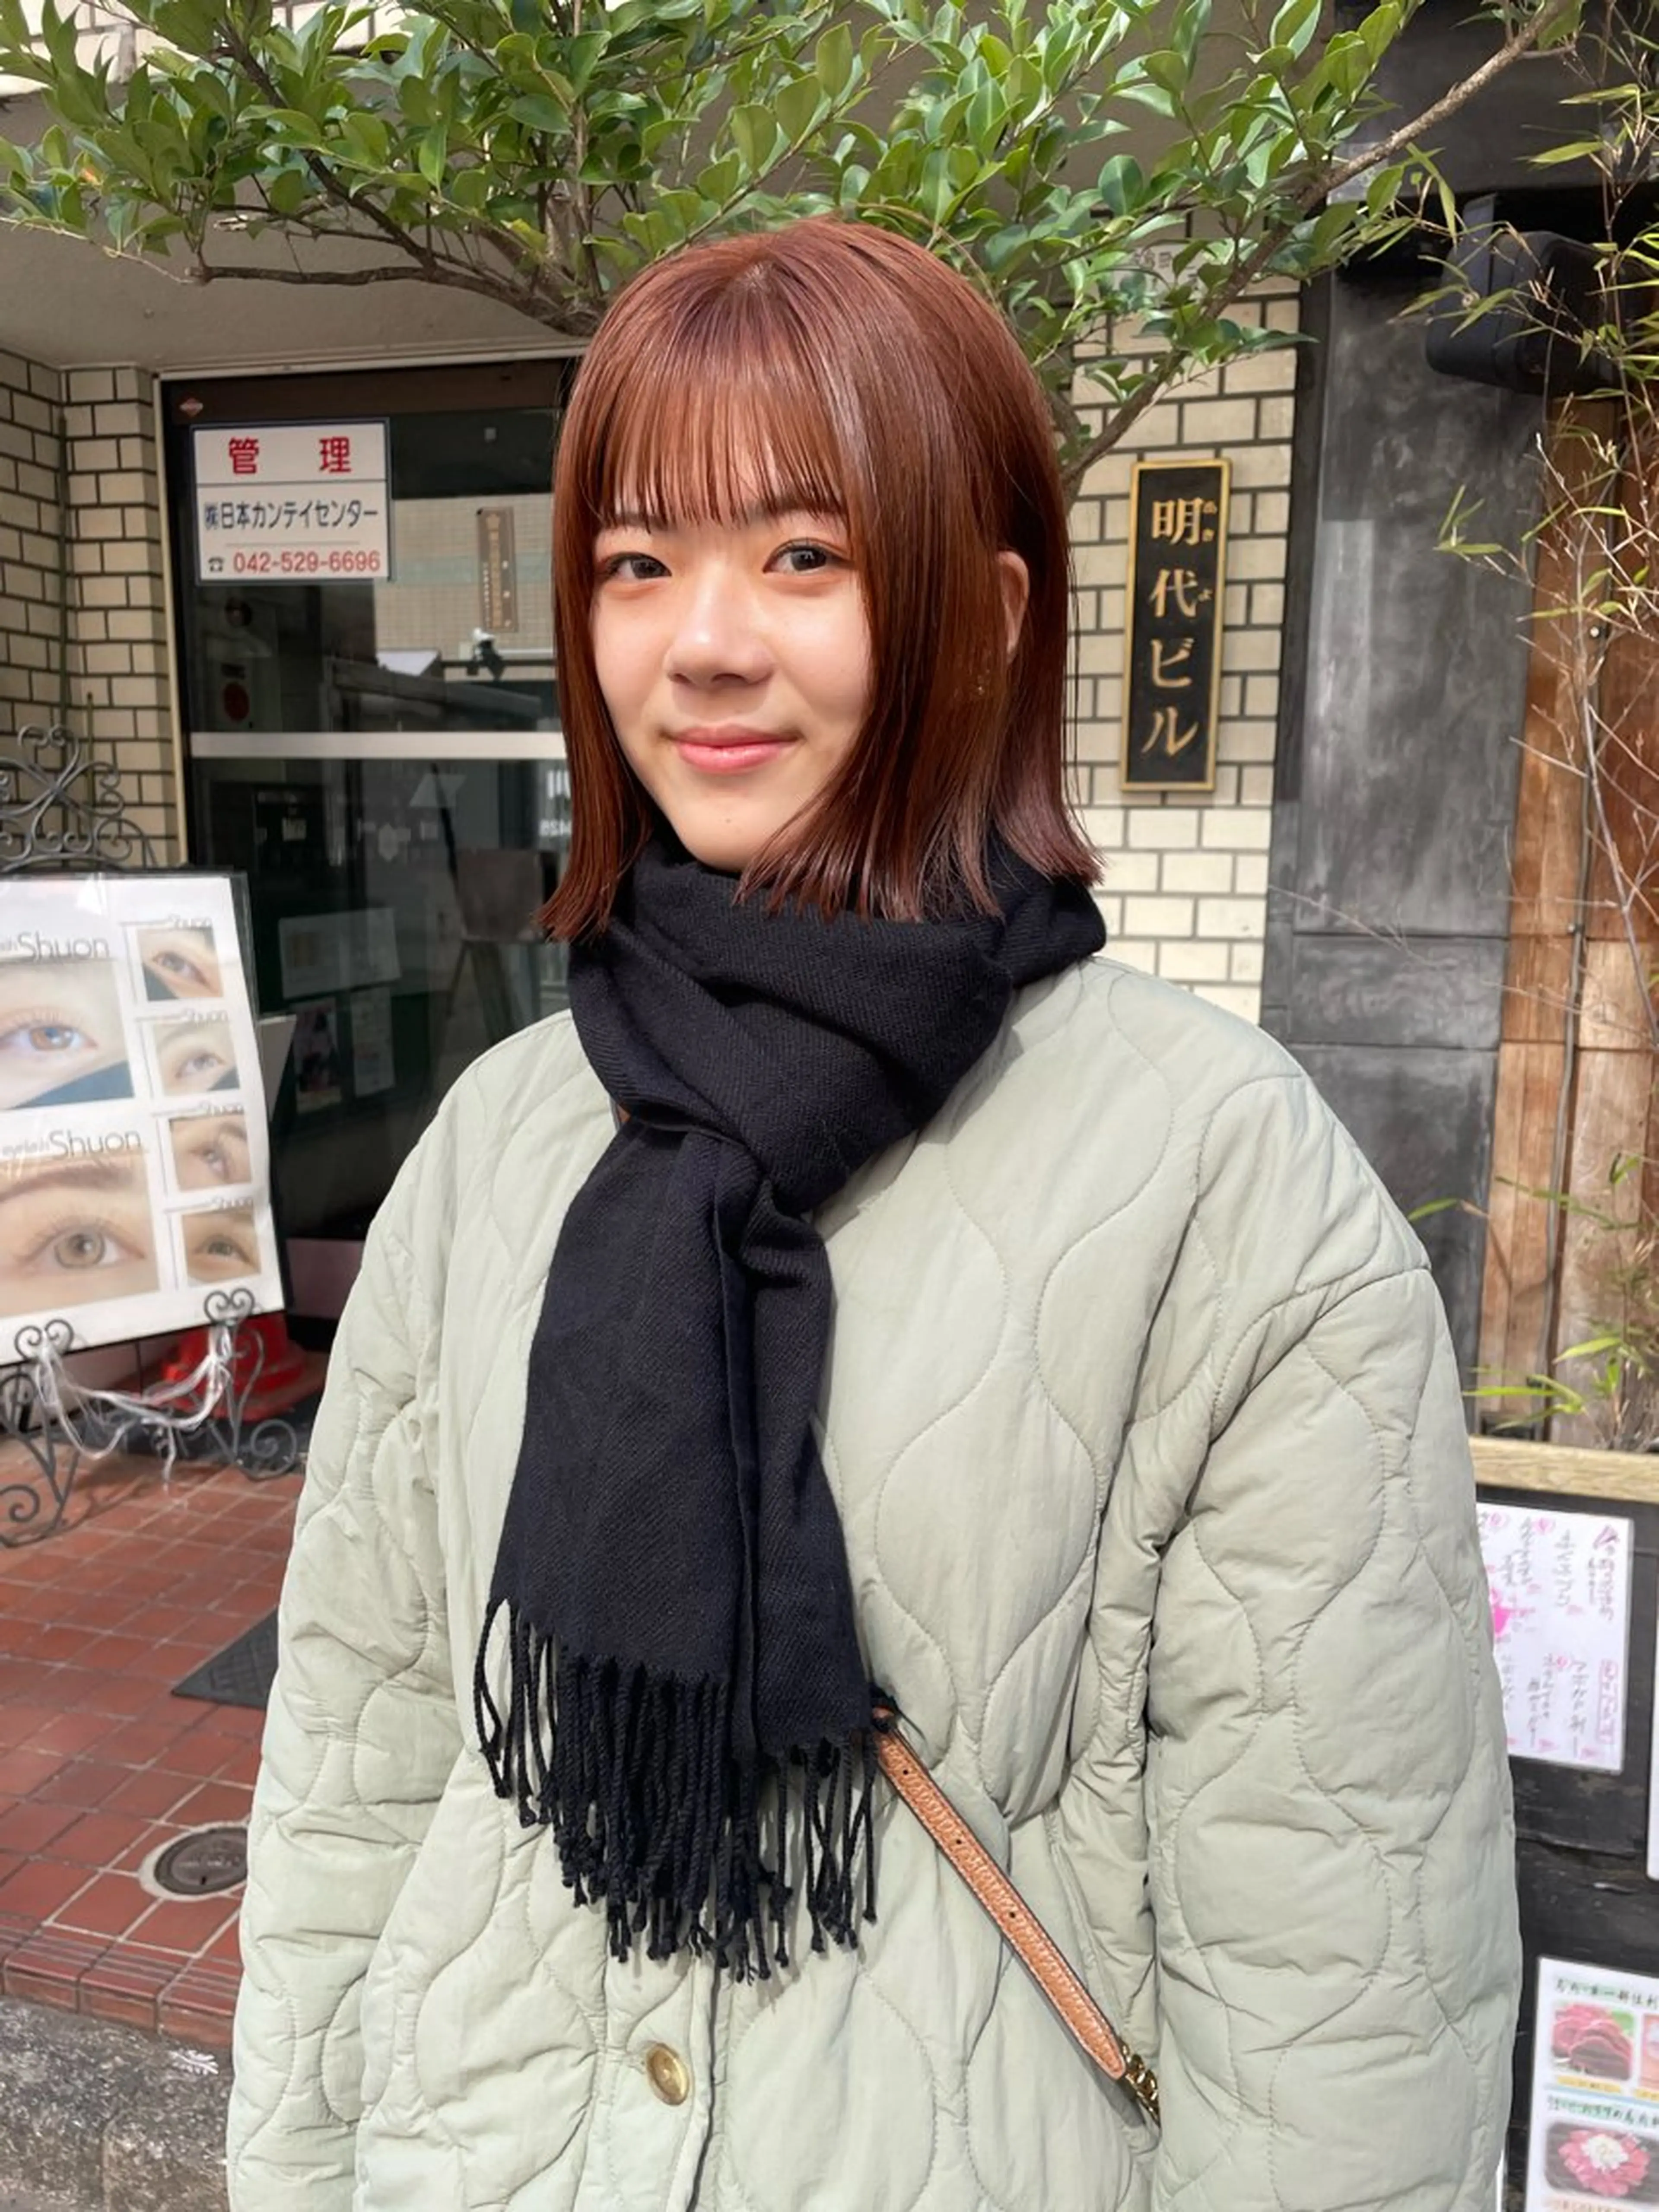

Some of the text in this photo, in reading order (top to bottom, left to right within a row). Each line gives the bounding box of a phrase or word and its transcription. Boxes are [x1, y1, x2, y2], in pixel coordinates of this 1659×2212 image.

[233, 550, 380, 573] 042-529-6696
[1142, 497, 1204, 756] 明代ビル
[17, 929, 110, 961] Shuon
[49, 1129, 141, 1159] Shuon
